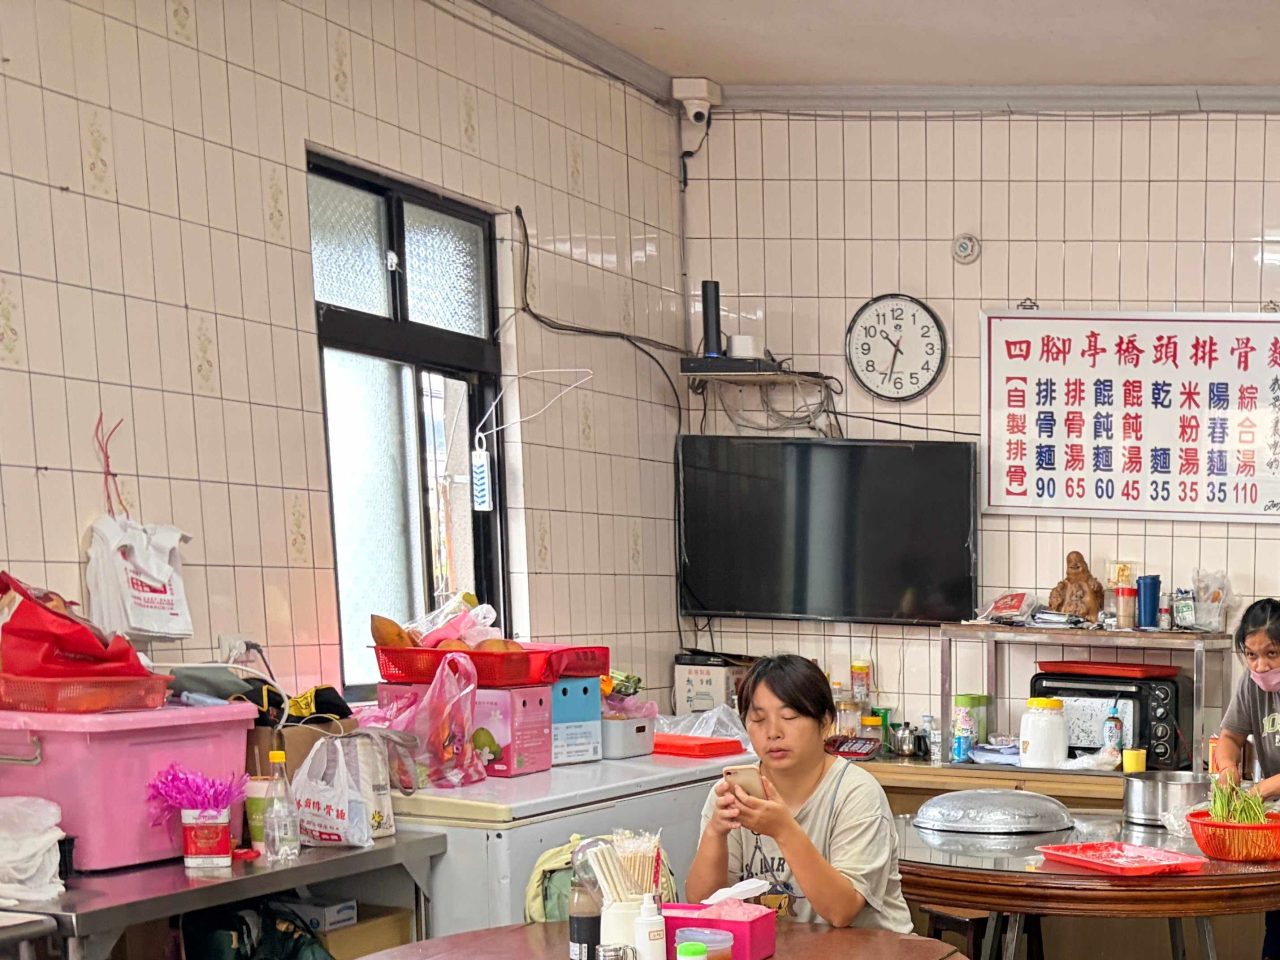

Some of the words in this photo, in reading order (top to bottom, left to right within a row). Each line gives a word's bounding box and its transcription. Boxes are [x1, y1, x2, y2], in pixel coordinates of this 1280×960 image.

[876, 312, 887, 325] 11
[890, 307, 904, 321] 12
[911, 312, 916, 325] 1
[863, 325, 877, 338] 10
[920, 325, 931, 338] 2
[861, 342, 871, 355] 9
[925, 342, 935, 355] 3
[865, 360, 876, 373] 8
[921, 360, 931, 373] 4
[879, 372, 888, 385] 7
[893, 377, 903, 390] 6
[909, 372, 920, 385] 5
[1035, 378, 1057, 472] 排骨麵
[1064, 378, 1086, 473] 排骨湯
[1092, 378, 1114, 473] 餛飩麵
[1121, 379, 1143, 474] 餛飩湯
[1179, 381, 1201, 477] 米粉湯
[1207, 382, 1229, 478] 陽春麵
[1235, 384, 1259, 478] 綜合湯
[1035, 477, 1056, 499] 90
[1064, 477, 1086, 499] 65
[1094, 478, 1115, 500] 60
[1121, 479, 1141, 501] 45
[1150, 481, 1171, 502] 35
[1178, 481, 1199, 502] 35
[1206, 482, 1227, 503] 35
[1233, 482, 1258, 504] 110
